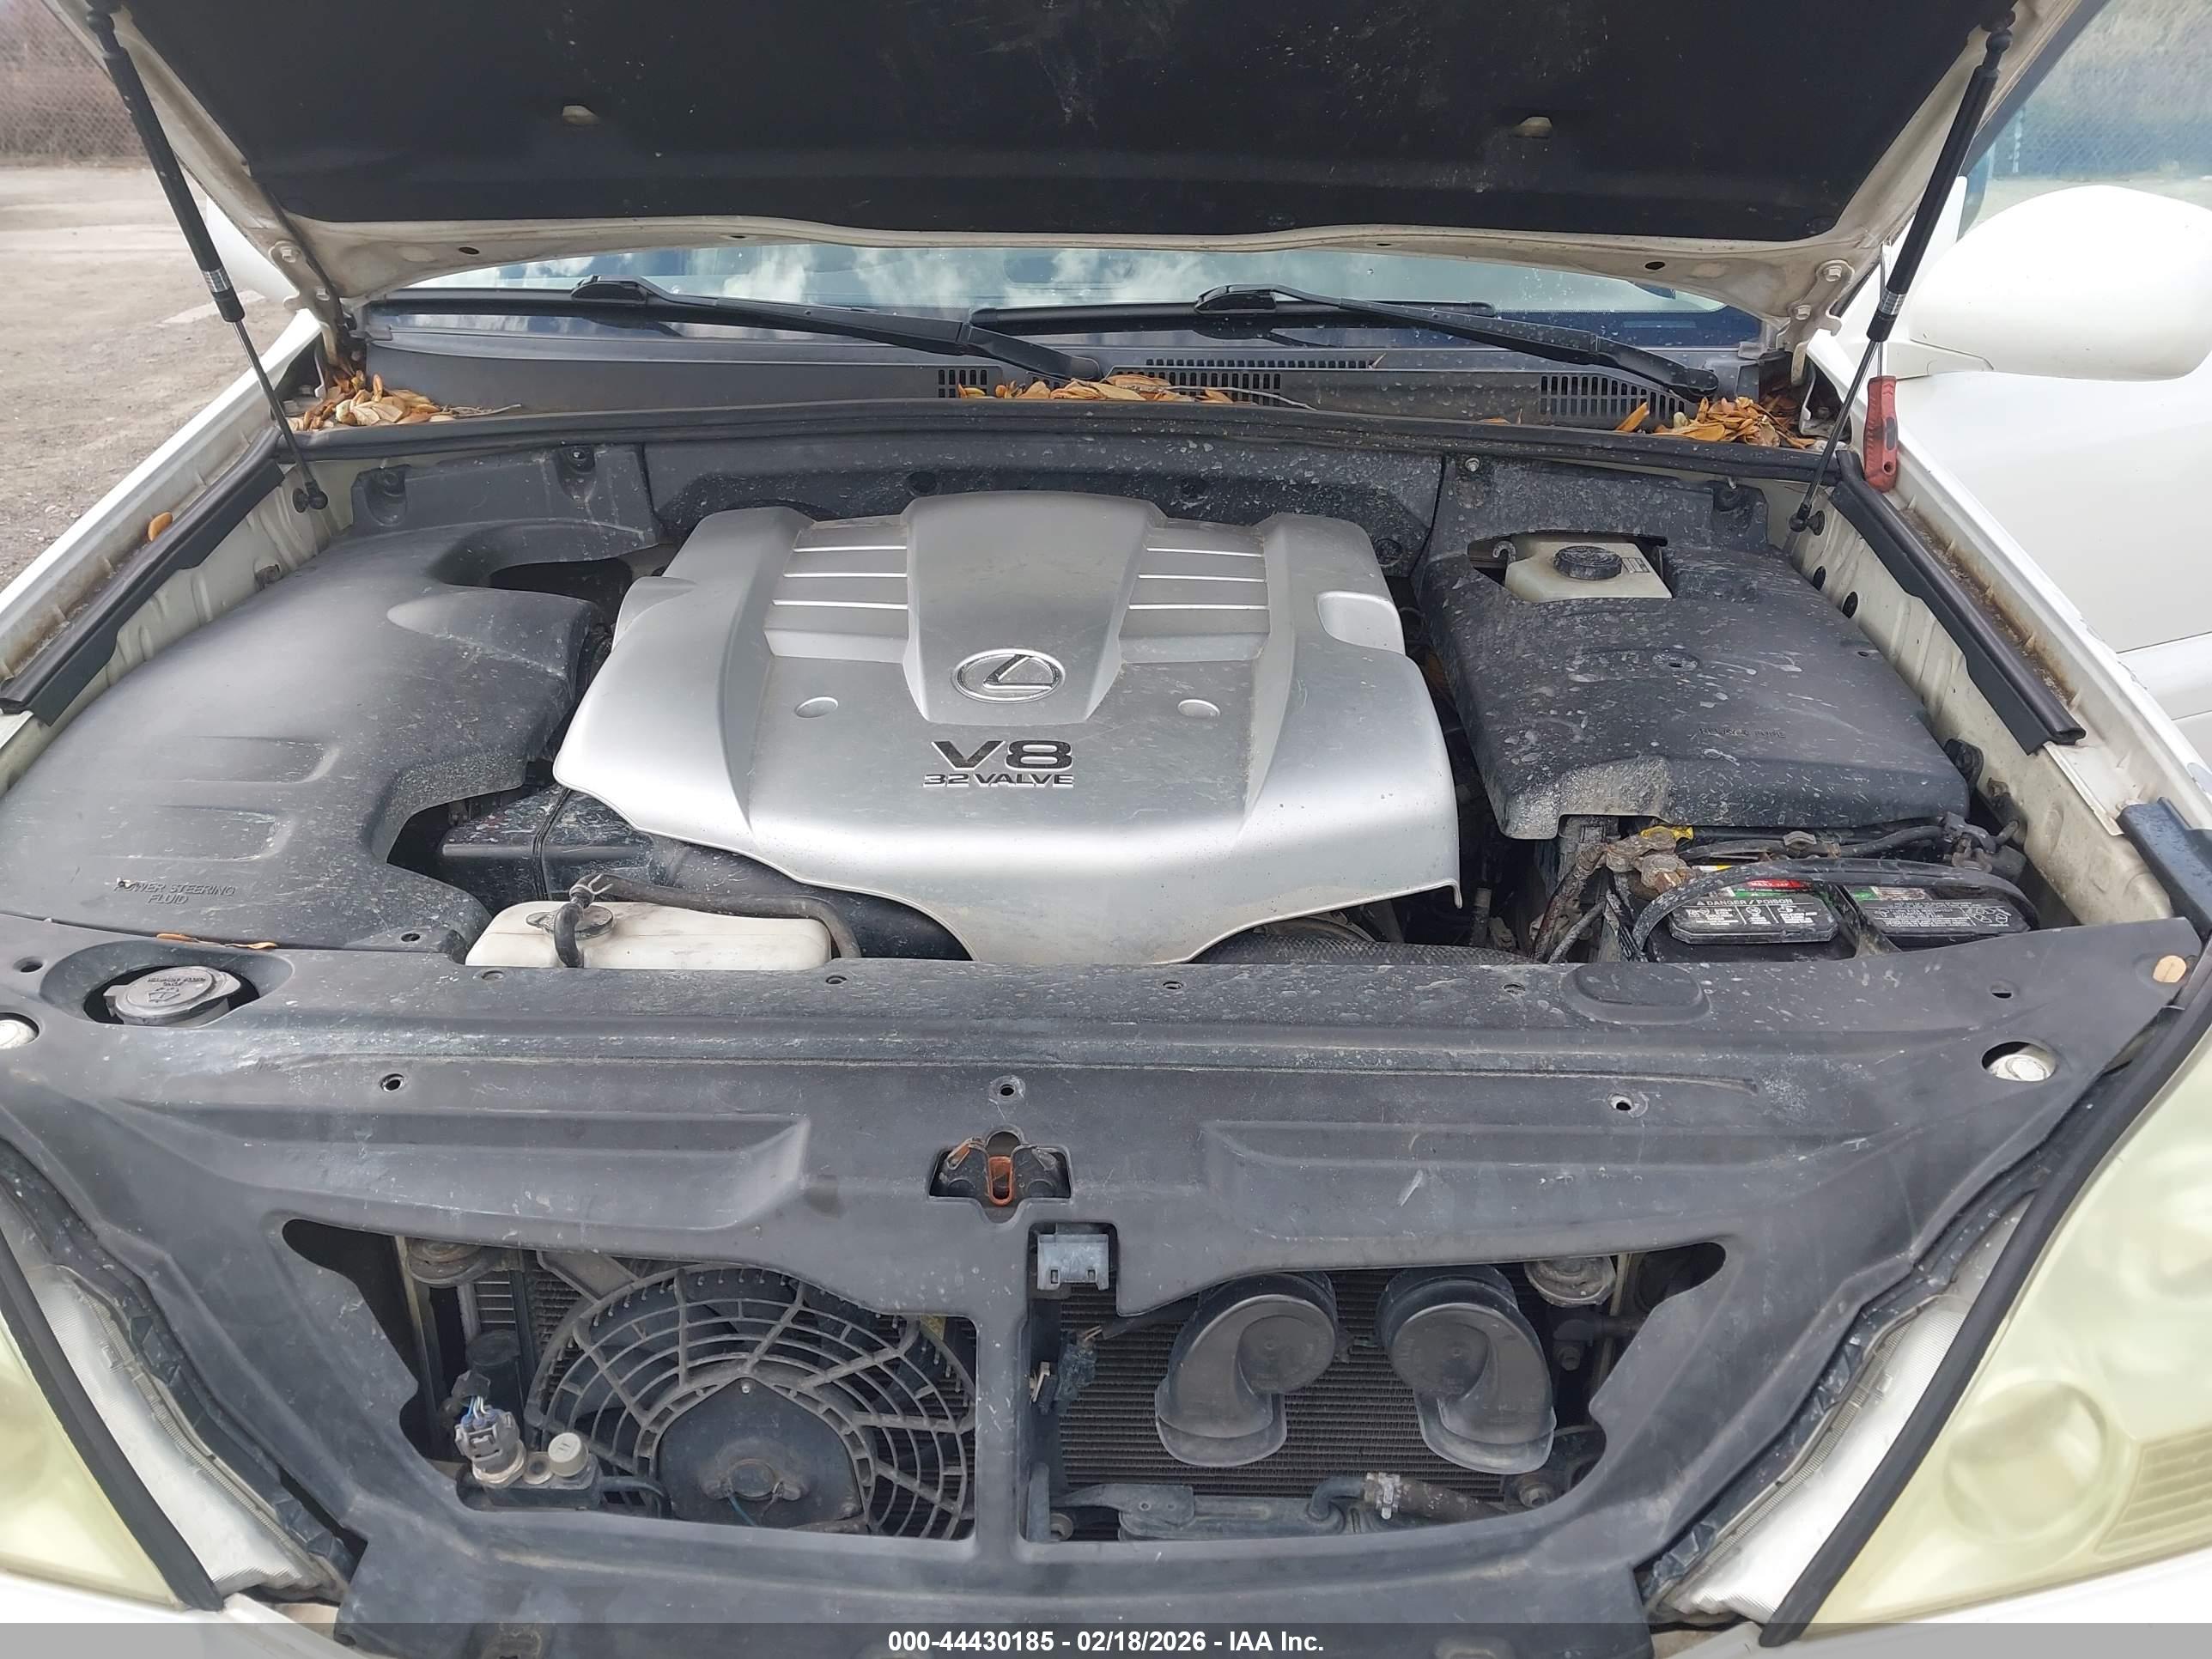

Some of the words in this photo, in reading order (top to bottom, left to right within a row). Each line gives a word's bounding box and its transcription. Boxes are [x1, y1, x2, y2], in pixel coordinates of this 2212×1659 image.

[931, 740, 1073, 772] V8
[922, 774, 969, 787] 32
[973, 774, 1074, 787] VALVE
[148, 894, 189, 904] FLUID
